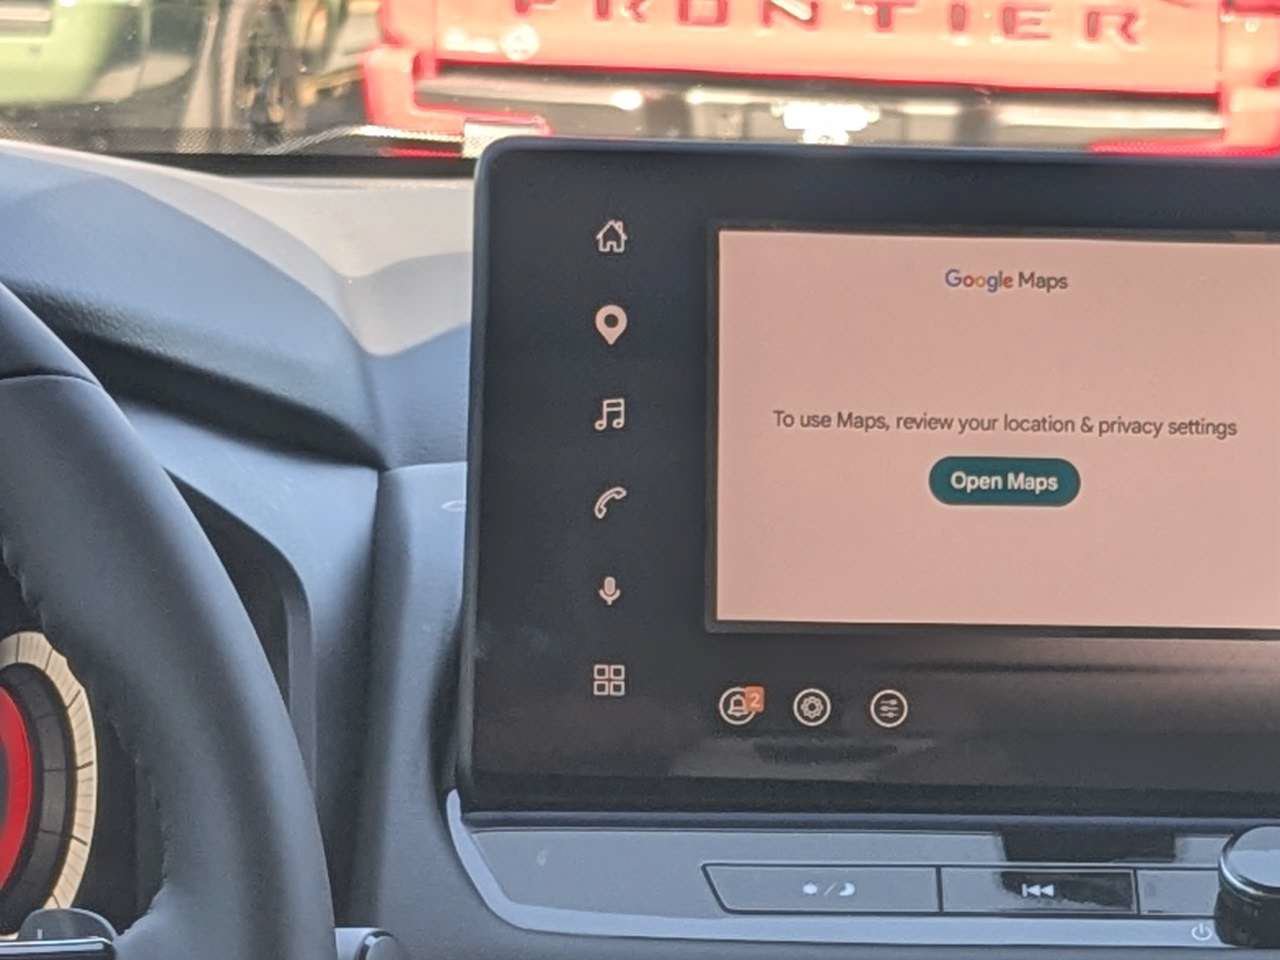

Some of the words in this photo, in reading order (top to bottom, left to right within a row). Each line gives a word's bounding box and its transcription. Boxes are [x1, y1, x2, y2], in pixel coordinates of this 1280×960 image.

[945, 268, 1014, 293] Google
[1018, 271, 1069, 293] Maps
[773, 410, 795, 427] To
[800, 413, 831, 428] use
[836, 411, 890, 432] Maps,
[896, 413, 954, 430] review
[958, 416, 999, 434] your
[1003, 414, 1075, 433] location
[1080, 416, 1094, 433] &
[1098, 416, 1163, 438] privacy
[1168, 419, 1237, 440] settings
[950, 471, 1003, 493] Open
[1007, 472, 1059, 494] Maps
